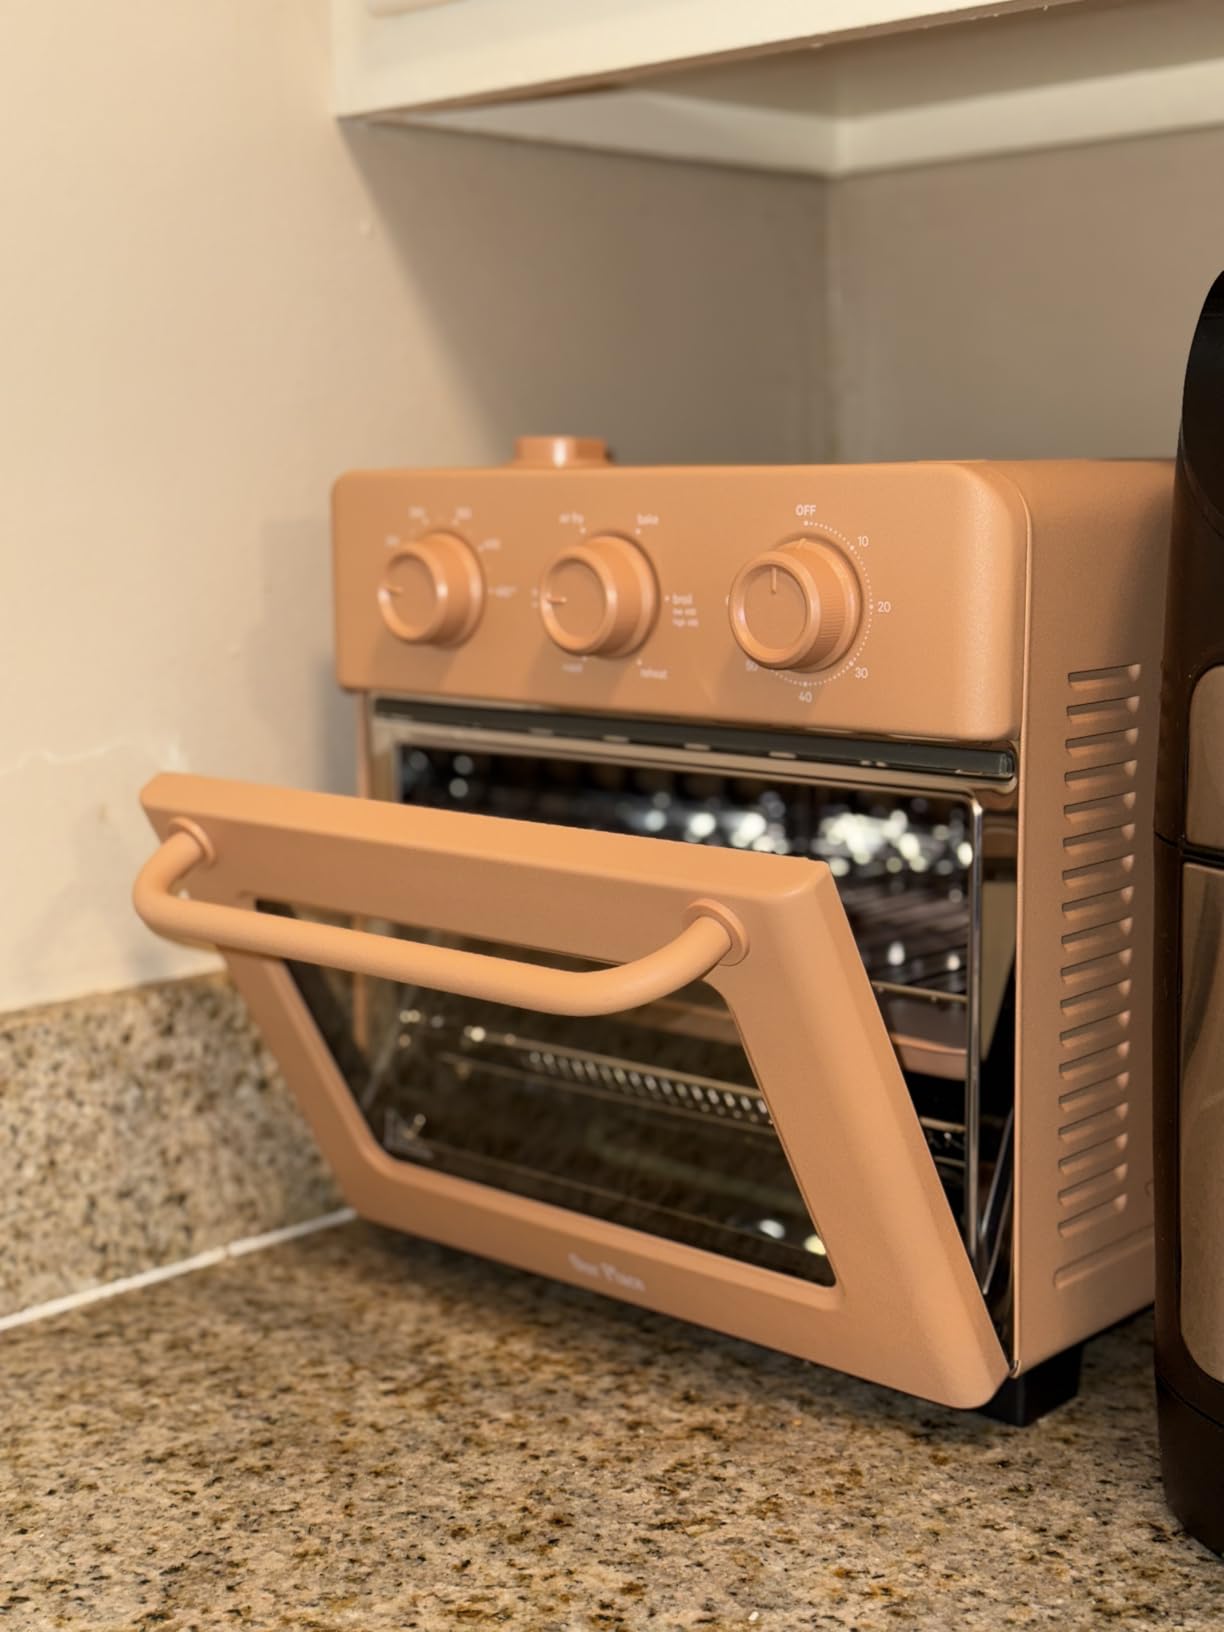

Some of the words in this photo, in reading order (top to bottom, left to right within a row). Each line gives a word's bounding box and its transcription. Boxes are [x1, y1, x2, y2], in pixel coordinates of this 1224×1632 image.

[795, 504, 817, 516] OFF
[857, 535, 869, 547] 10
[877, 601, 891, 613] 20
[855, 667, 869, 679] 30
[799, 691, 813, 703] 40
